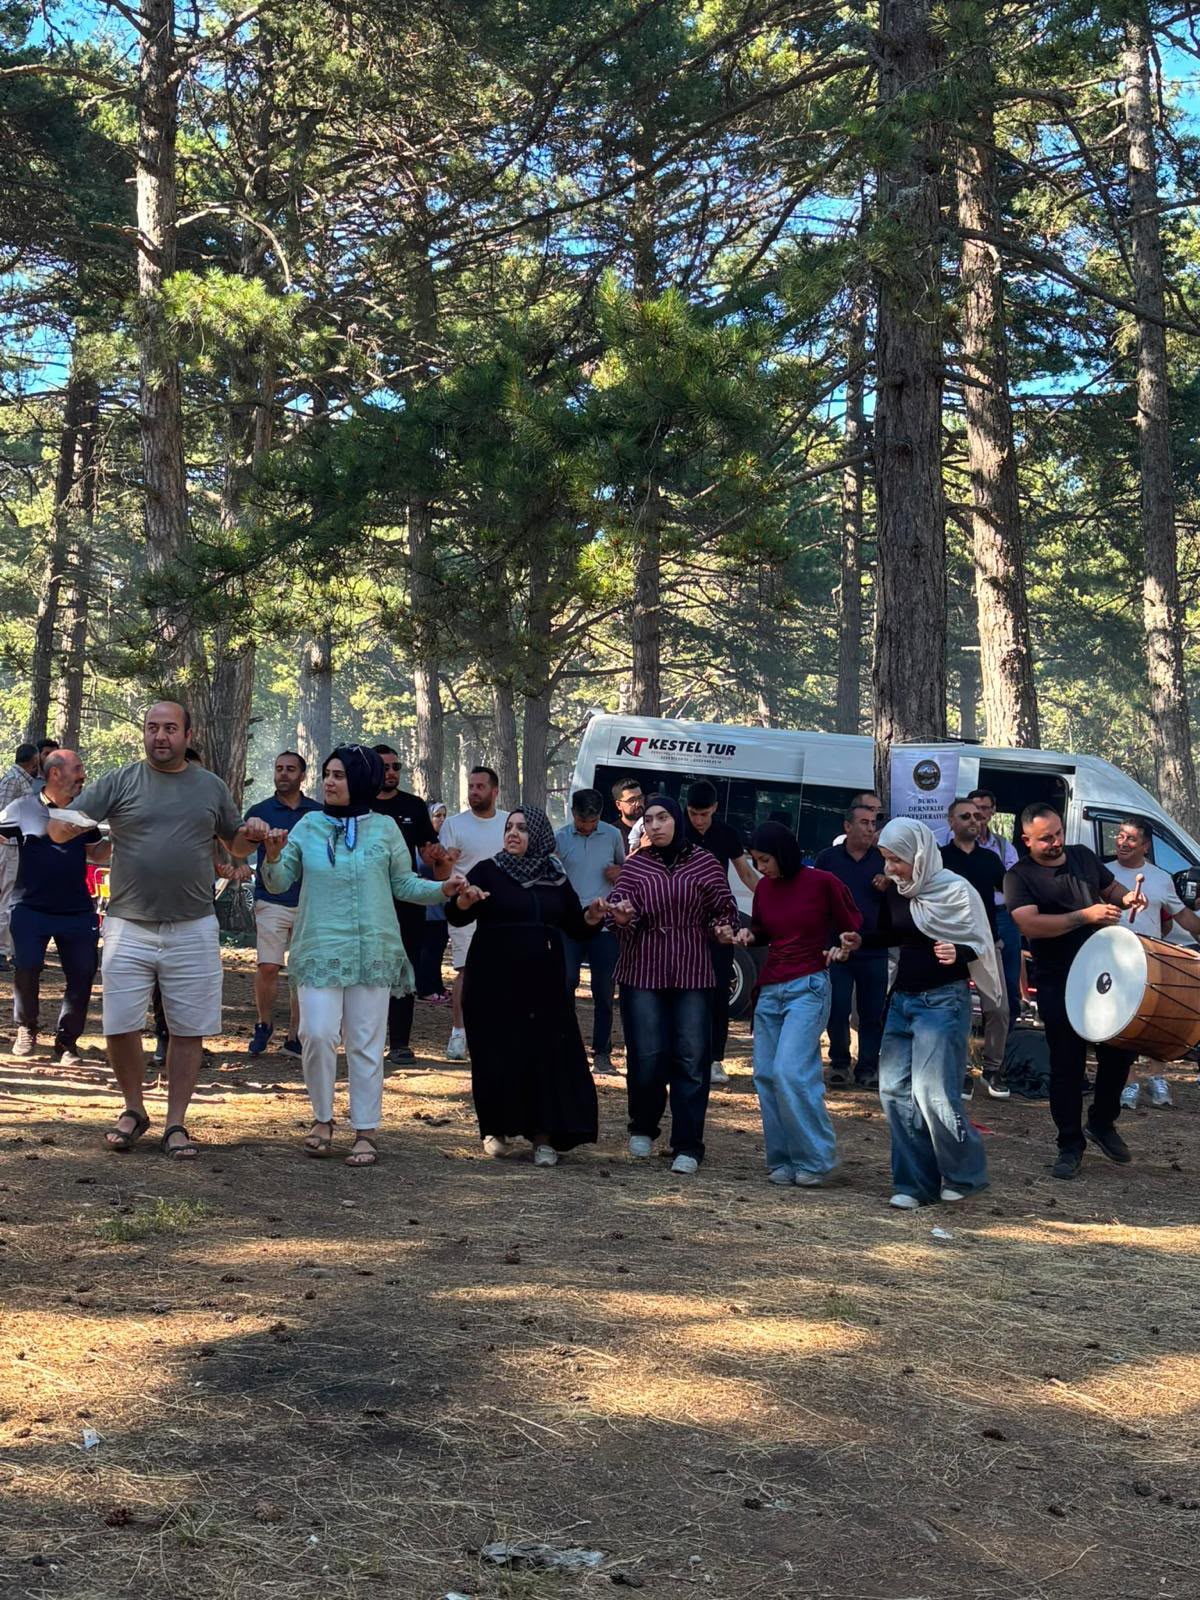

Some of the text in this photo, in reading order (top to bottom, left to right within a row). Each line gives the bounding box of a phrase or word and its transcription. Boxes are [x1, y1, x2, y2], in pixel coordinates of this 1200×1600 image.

[616, 736, 648, 757] KT
[648, 738, 702, 753] KESTEL
[706, 743, 736, 756] TUR
